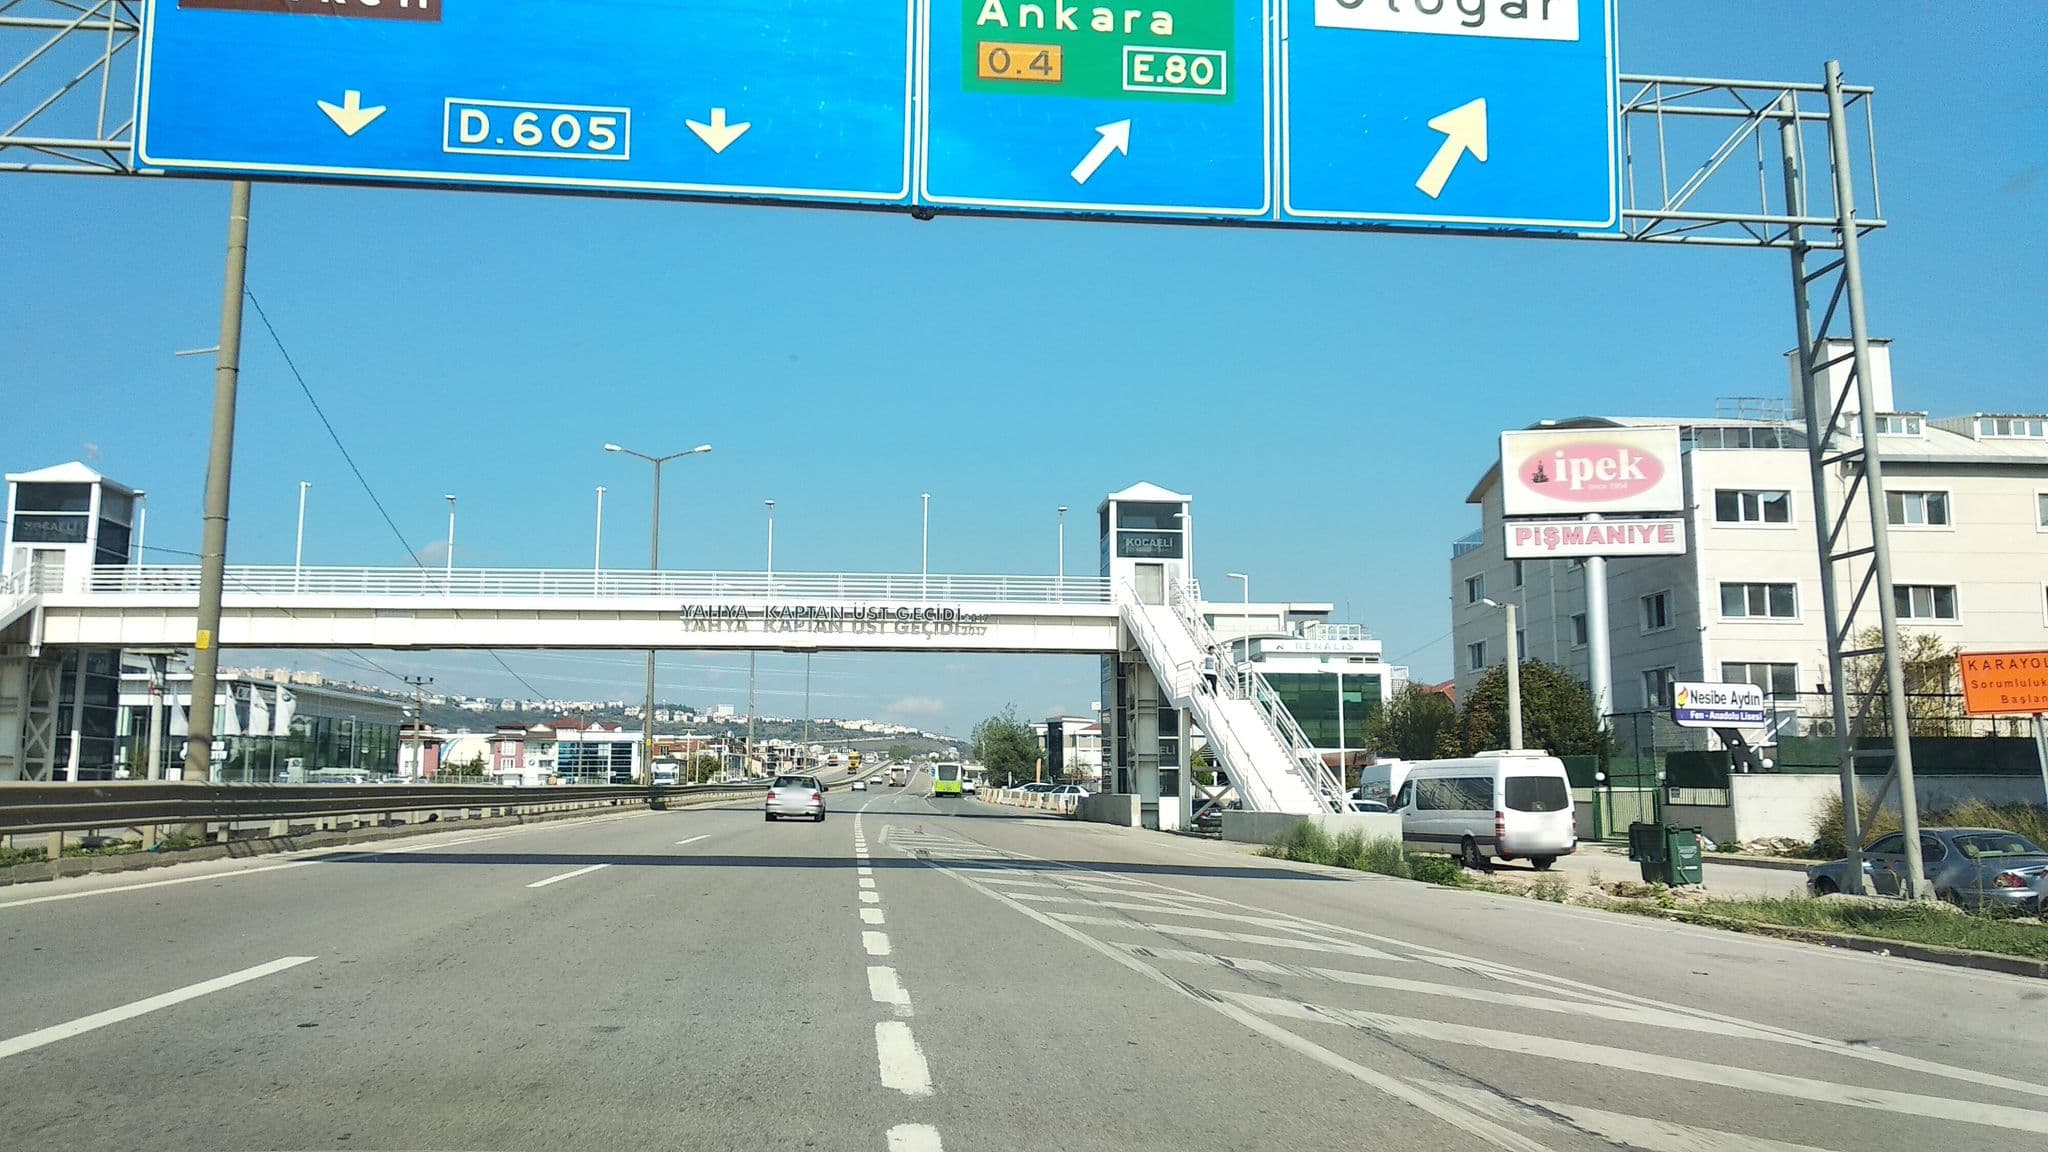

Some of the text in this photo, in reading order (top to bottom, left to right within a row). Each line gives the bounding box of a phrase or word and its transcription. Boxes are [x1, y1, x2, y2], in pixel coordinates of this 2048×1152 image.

[977, 0, 1173, 35] Ankara
[1133, 54, 1214, 86] E.80
[458, 108, 617, 151] D.605
[1553, 449, 1647, 490] ipek
[681, 604, 750, 618] YAHYA
[764, 605, 844, 620] KAPTAN
[854, 602, 888, 620] ÜST
[1690, 689, 1760, 709] Nesibe Aydın
[1971, 678, 2048, 689] Sorumluluk
